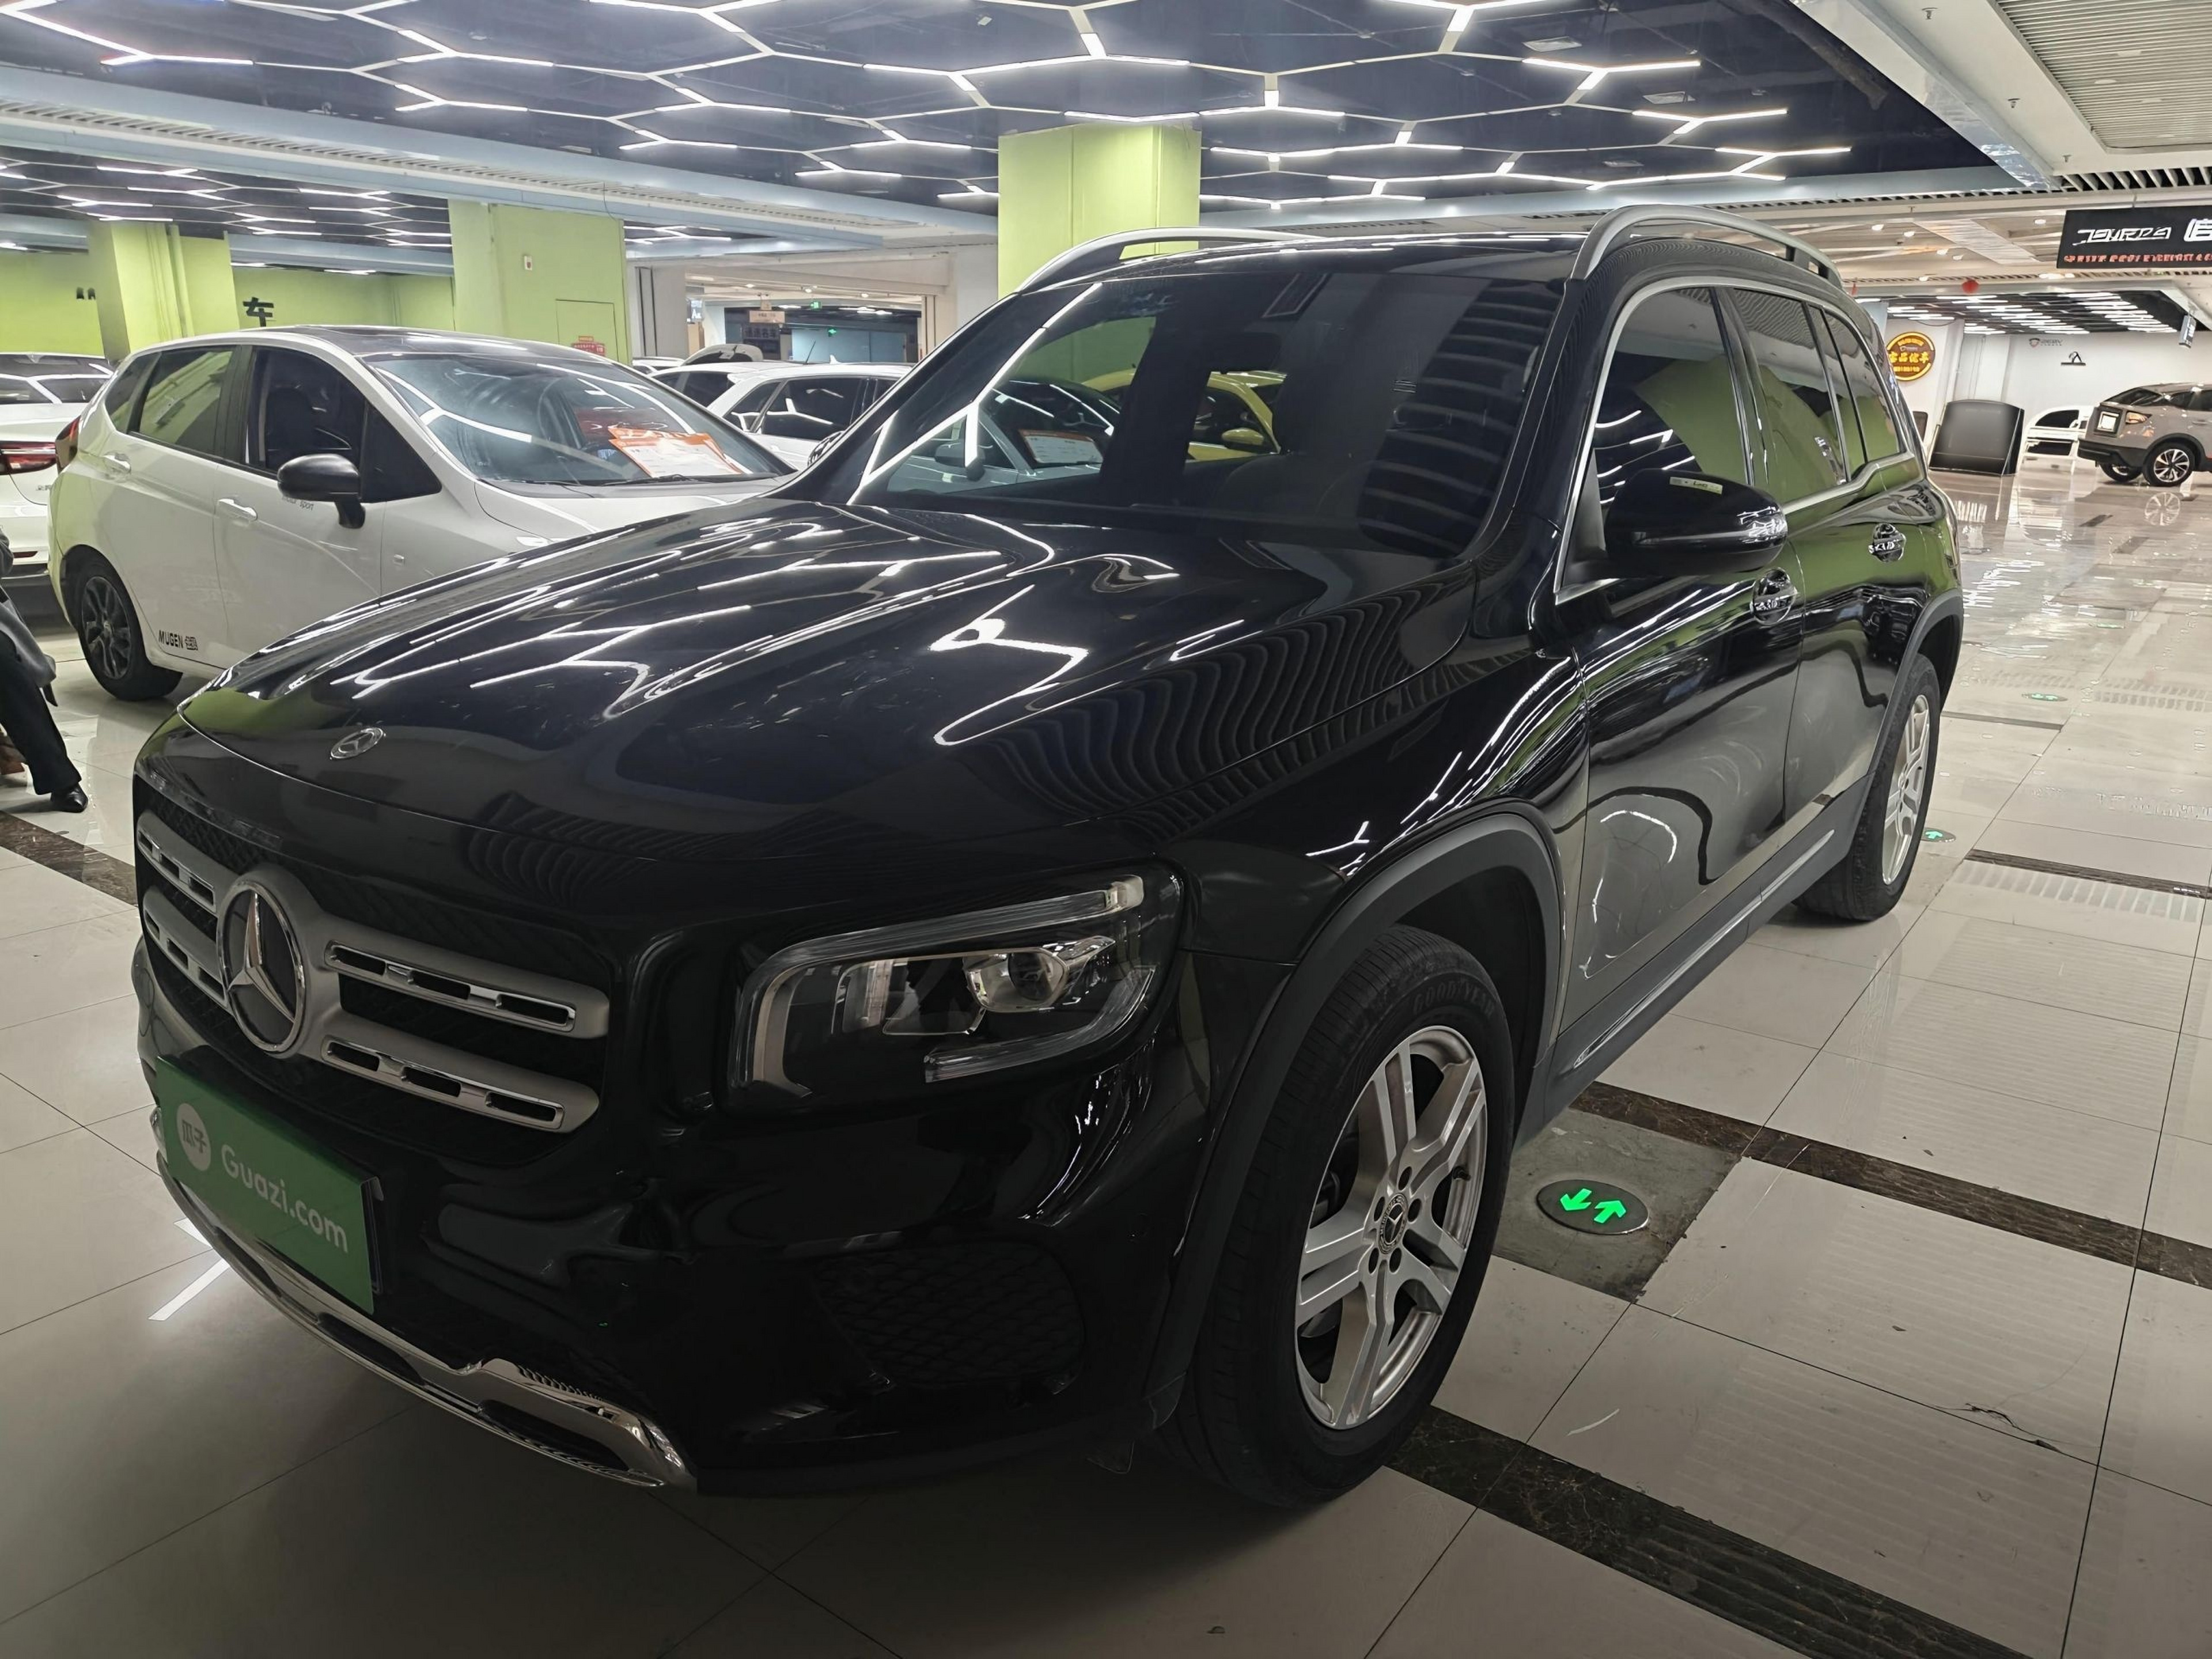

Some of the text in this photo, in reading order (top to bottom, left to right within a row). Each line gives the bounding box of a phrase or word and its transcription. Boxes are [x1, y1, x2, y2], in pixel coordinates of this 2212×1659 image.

[243, 297, 274, 327] 车
[158, 630, 183, 649] MUGEN
[182, 1119, 207, 1154] 瓜子
[221, 1143, 349, 1253] Guazi.com
